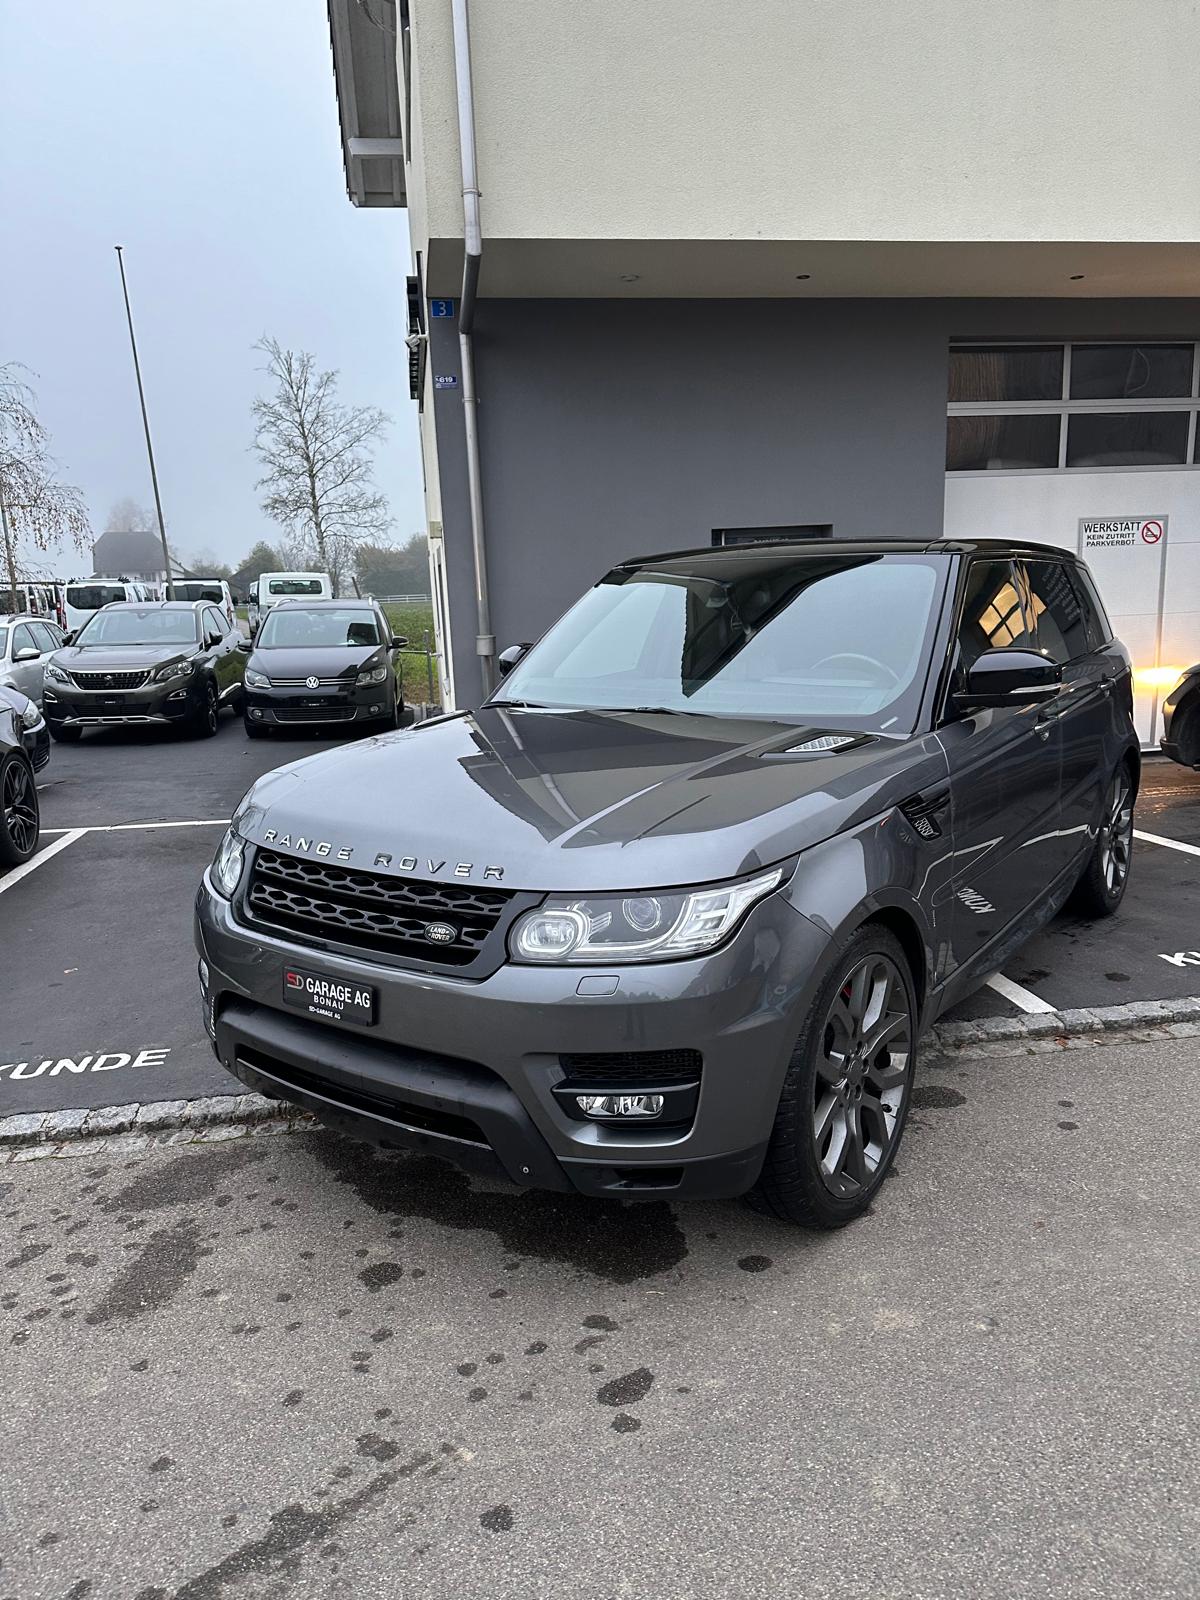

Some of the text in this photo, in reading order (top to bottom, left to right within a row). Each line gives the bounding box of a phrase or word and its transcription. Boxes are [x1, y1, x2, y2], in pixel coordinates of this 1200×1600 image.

[438, 301, 447, 315] 3
[1084, 521, 1141, 533] WERKSTATT
[1086, 539, 1136, 547] PARKVERBOT
[1106, 532, 1136, 540] ZUTRITT
[264, 829, 504, 880] RANGE ROVER
[306, 977, 352, 1003] GARAGE
[354, 990, 370, 1008] AG
[313, 994, 344, 1010] BONAU
